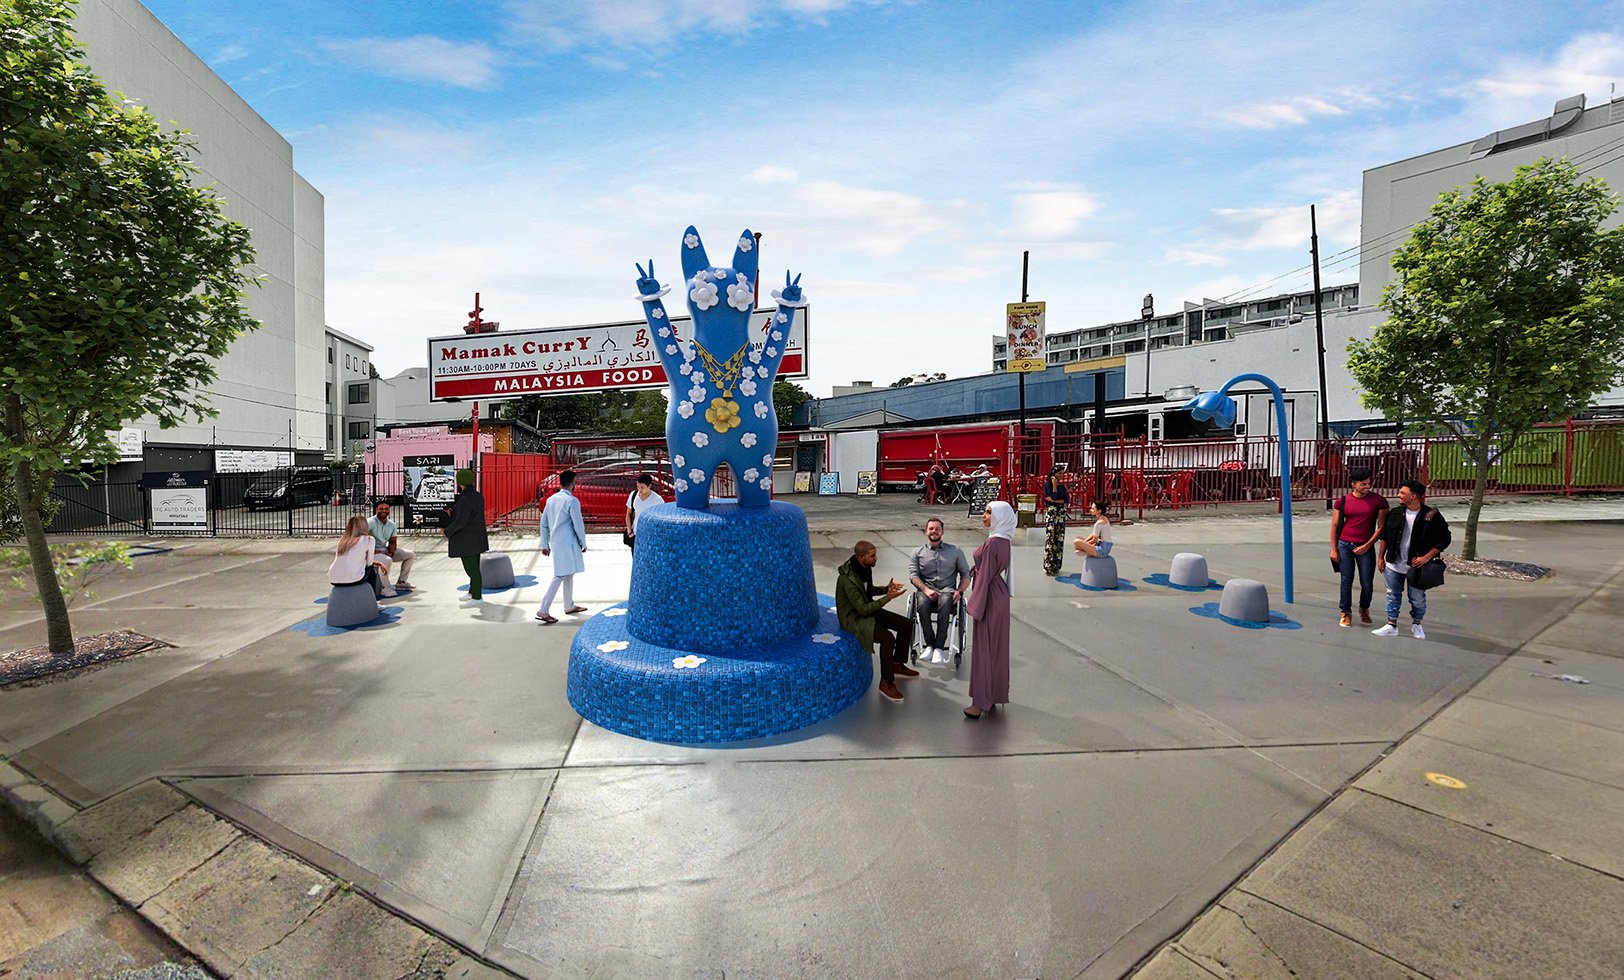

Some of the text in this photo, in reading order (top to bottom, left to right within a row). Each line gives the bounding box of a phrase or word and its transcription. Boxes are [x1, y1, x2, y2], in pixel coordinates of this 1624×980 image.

[441, 336, 592, 361] Mamak CurrY
[438, 360, 537, 374] 11:30AM-10:00PM 7DAYS
[494, 369, 653, 391] MALAYSIA FOOD
[416, 457, 440, 465] SARI
